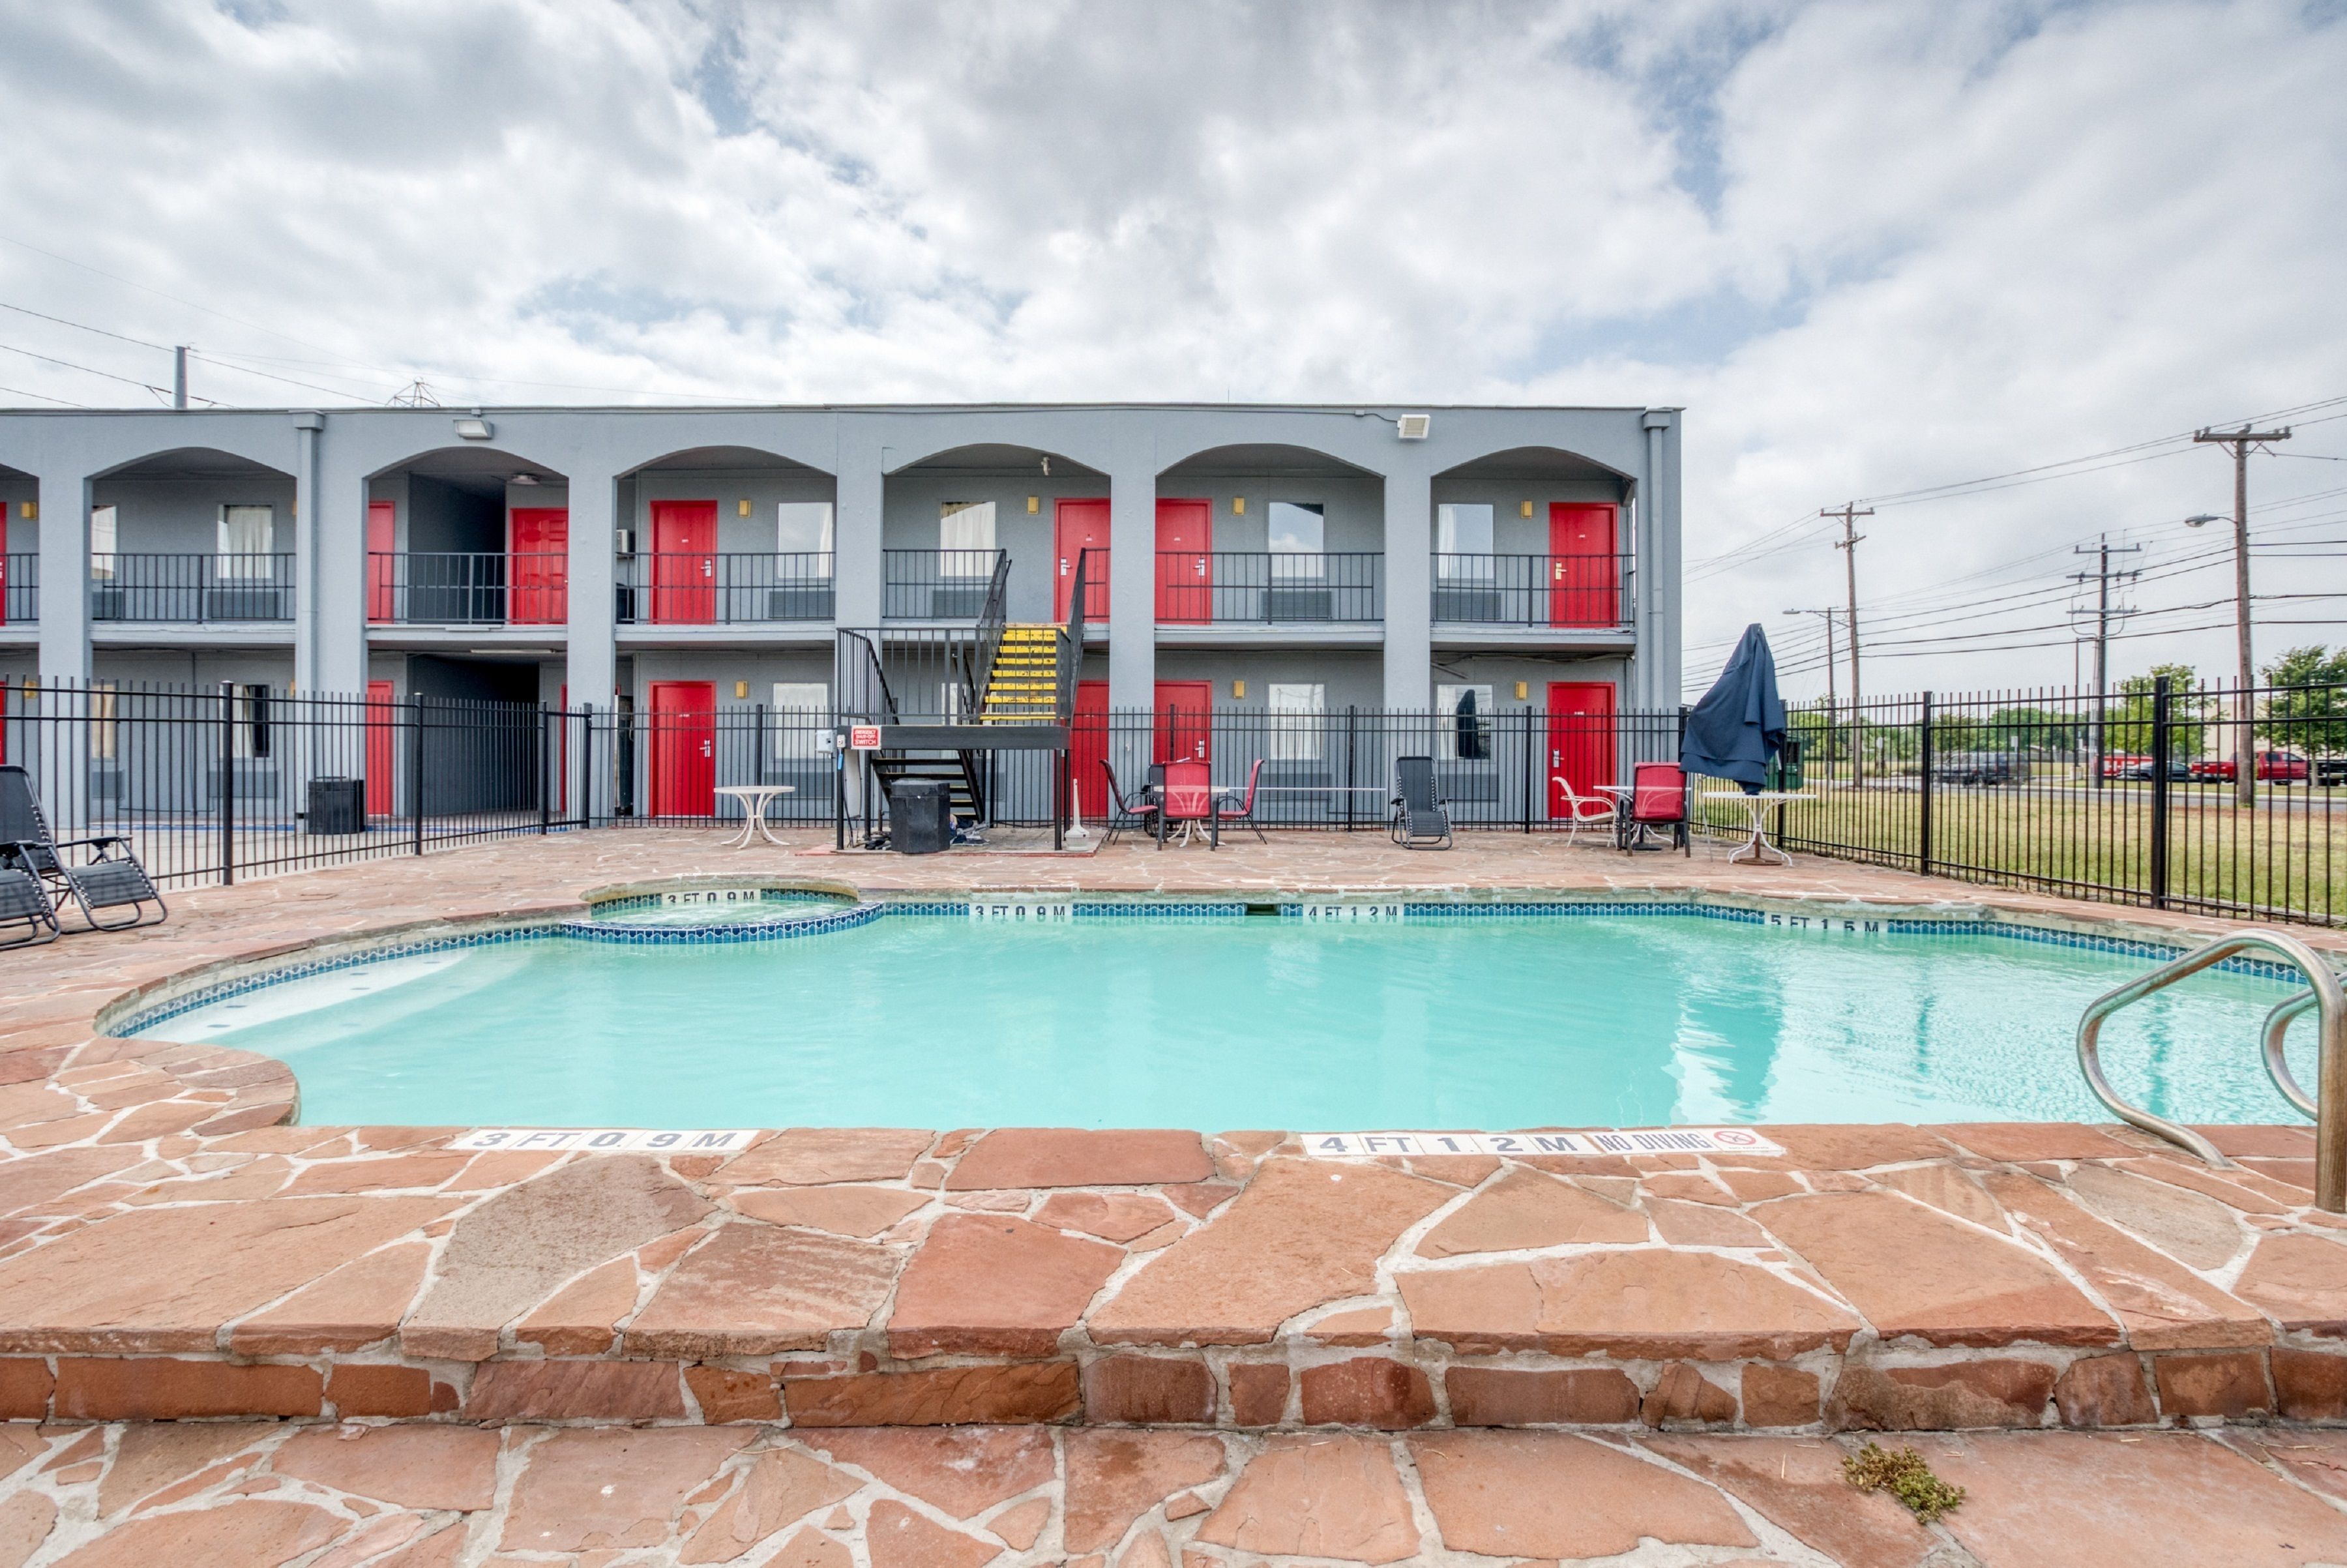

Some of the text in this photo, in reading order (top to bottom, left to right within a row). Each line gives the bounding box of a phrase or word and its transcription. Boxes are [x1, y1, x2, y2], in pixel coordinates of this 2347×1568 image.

[684, 893, 700, 903] FT
[743, 891, 754, 900] M
[975, 905, 984, 915] 3
[992, 906, 1009, 915] FT
[1054, 906, 1065, 915] M
[1325, 906, 1342, 916] FT
[1385, 906, 1397, 916] M
[1771, 914, 1781, 925] 5
[1790, 916, 1810, 928] FT
[1865, 921, 1879, 932] M
[472, 1132, 512, 1147] 3
[517, 1132, 582, 1147] FT
[692, 1132, 738, 1147] M
[1319, 1136, 1348, 1152] 4
[1365, 1136, 1411, 1153] FT
[1535, 1136, 1578, 1151] M
[1594, 1134, 1633, 1151] NO
[1632, 1132, 1713, 1150] DIVING
